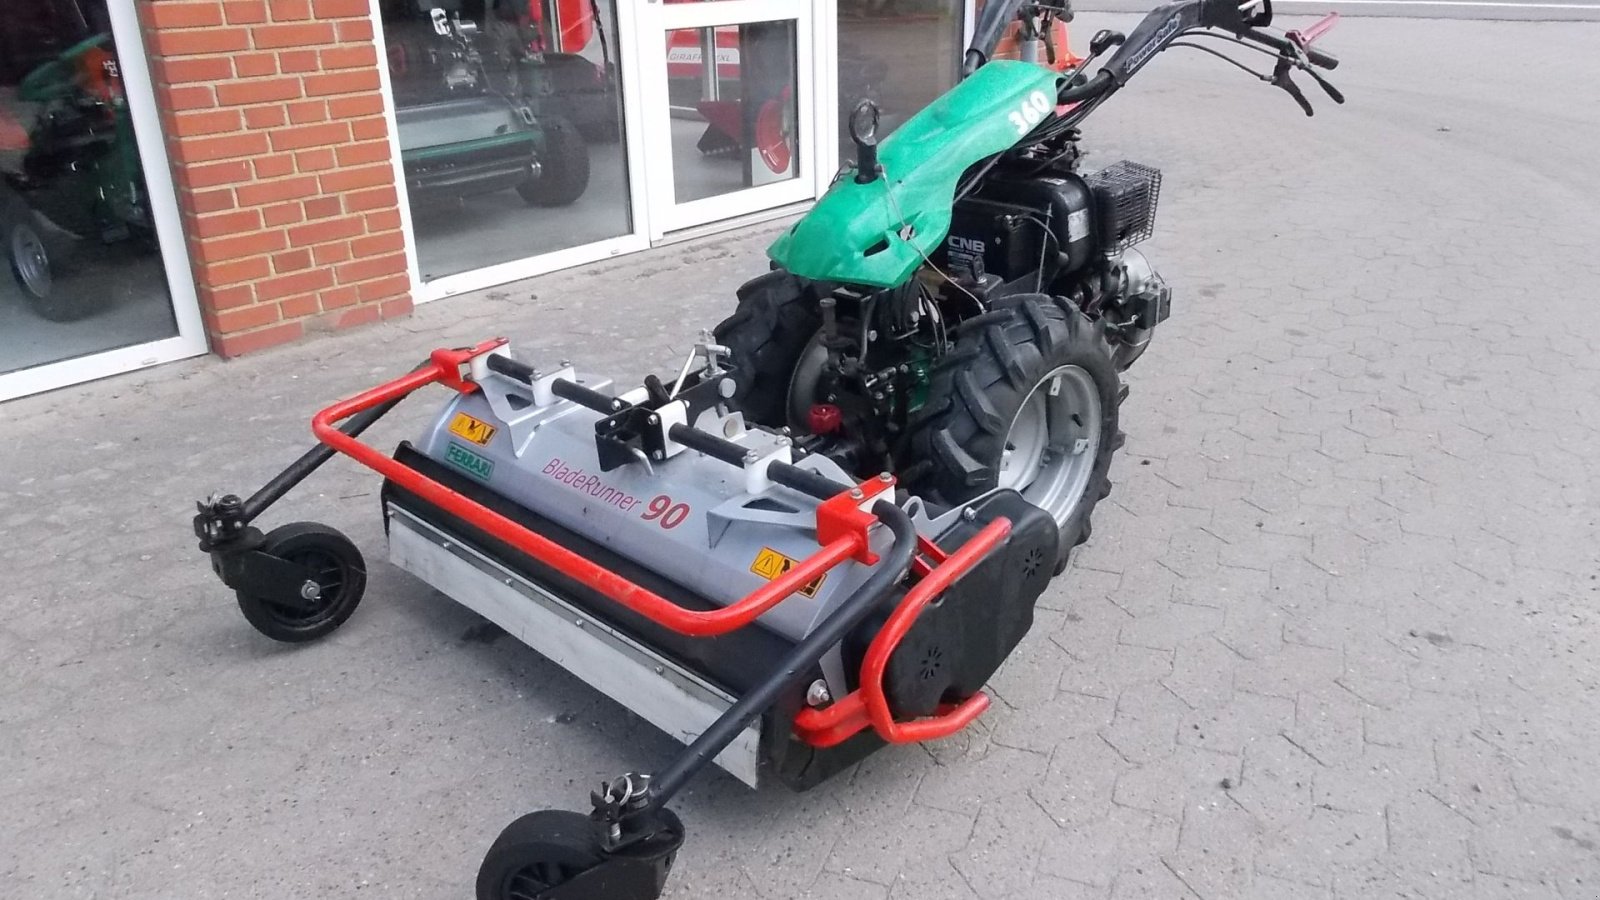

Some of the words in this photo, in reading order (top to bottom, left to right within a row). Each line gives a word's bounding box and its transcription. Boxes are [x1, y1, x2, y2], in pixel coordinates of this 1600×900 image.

[1008, 90, 1050, 135] 360
[948, 235, 985, 253] CNB
[447, 445, 493, 478] FERRARI
[542, 458, 642, 512] BladeRunner
[640, 494, 691, 530] 90
